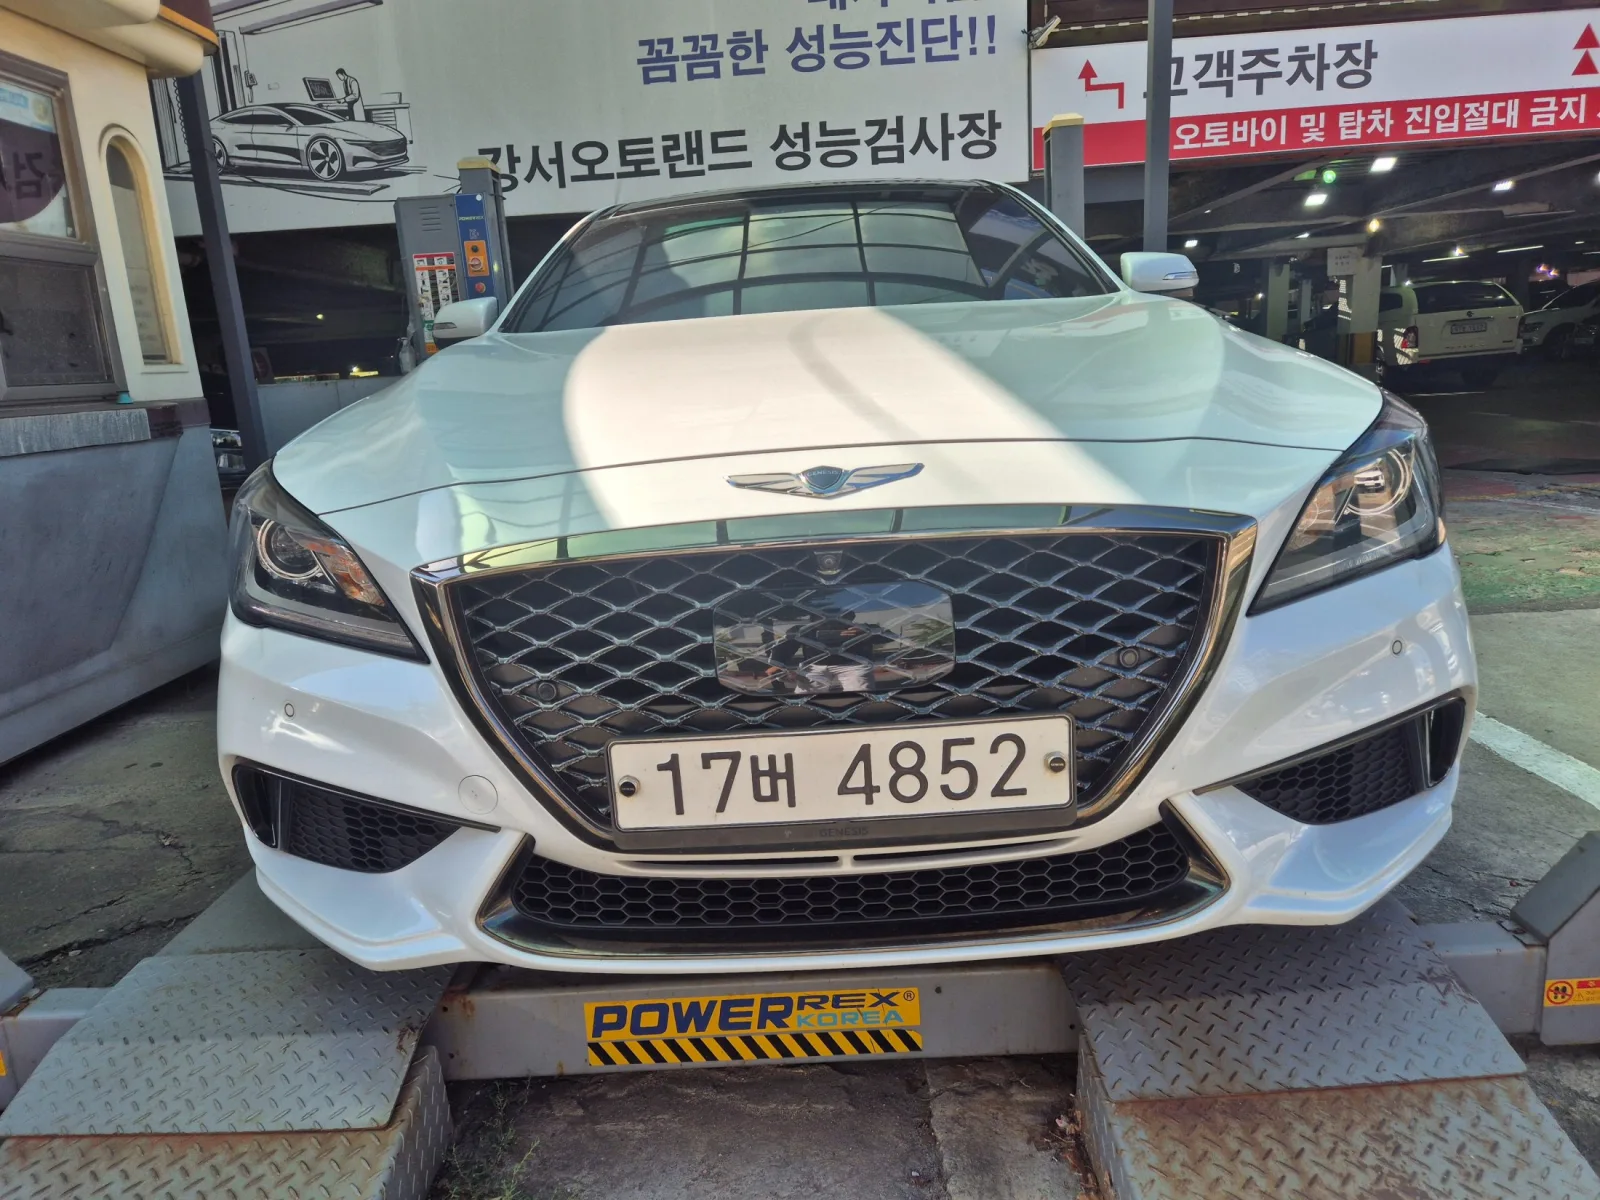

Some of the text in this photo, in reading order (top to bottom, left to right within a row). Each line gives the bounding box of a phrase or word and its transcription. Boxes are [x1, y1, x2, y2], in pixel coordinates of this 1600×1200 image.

[637, 15, 996, 85] 꼼꼼한 성능진단!!
[478, 109, 1002, 192] 강서오토랜드 성능검사장
[1173, 93, 1587, 150] 오토바이 및 탑차 진입절대 금지
[657, 733, 1028, 815] 17버 4852
[819, 826, 869, 838] GENESIS
[796, 1010, 904, 1028] KOREA
